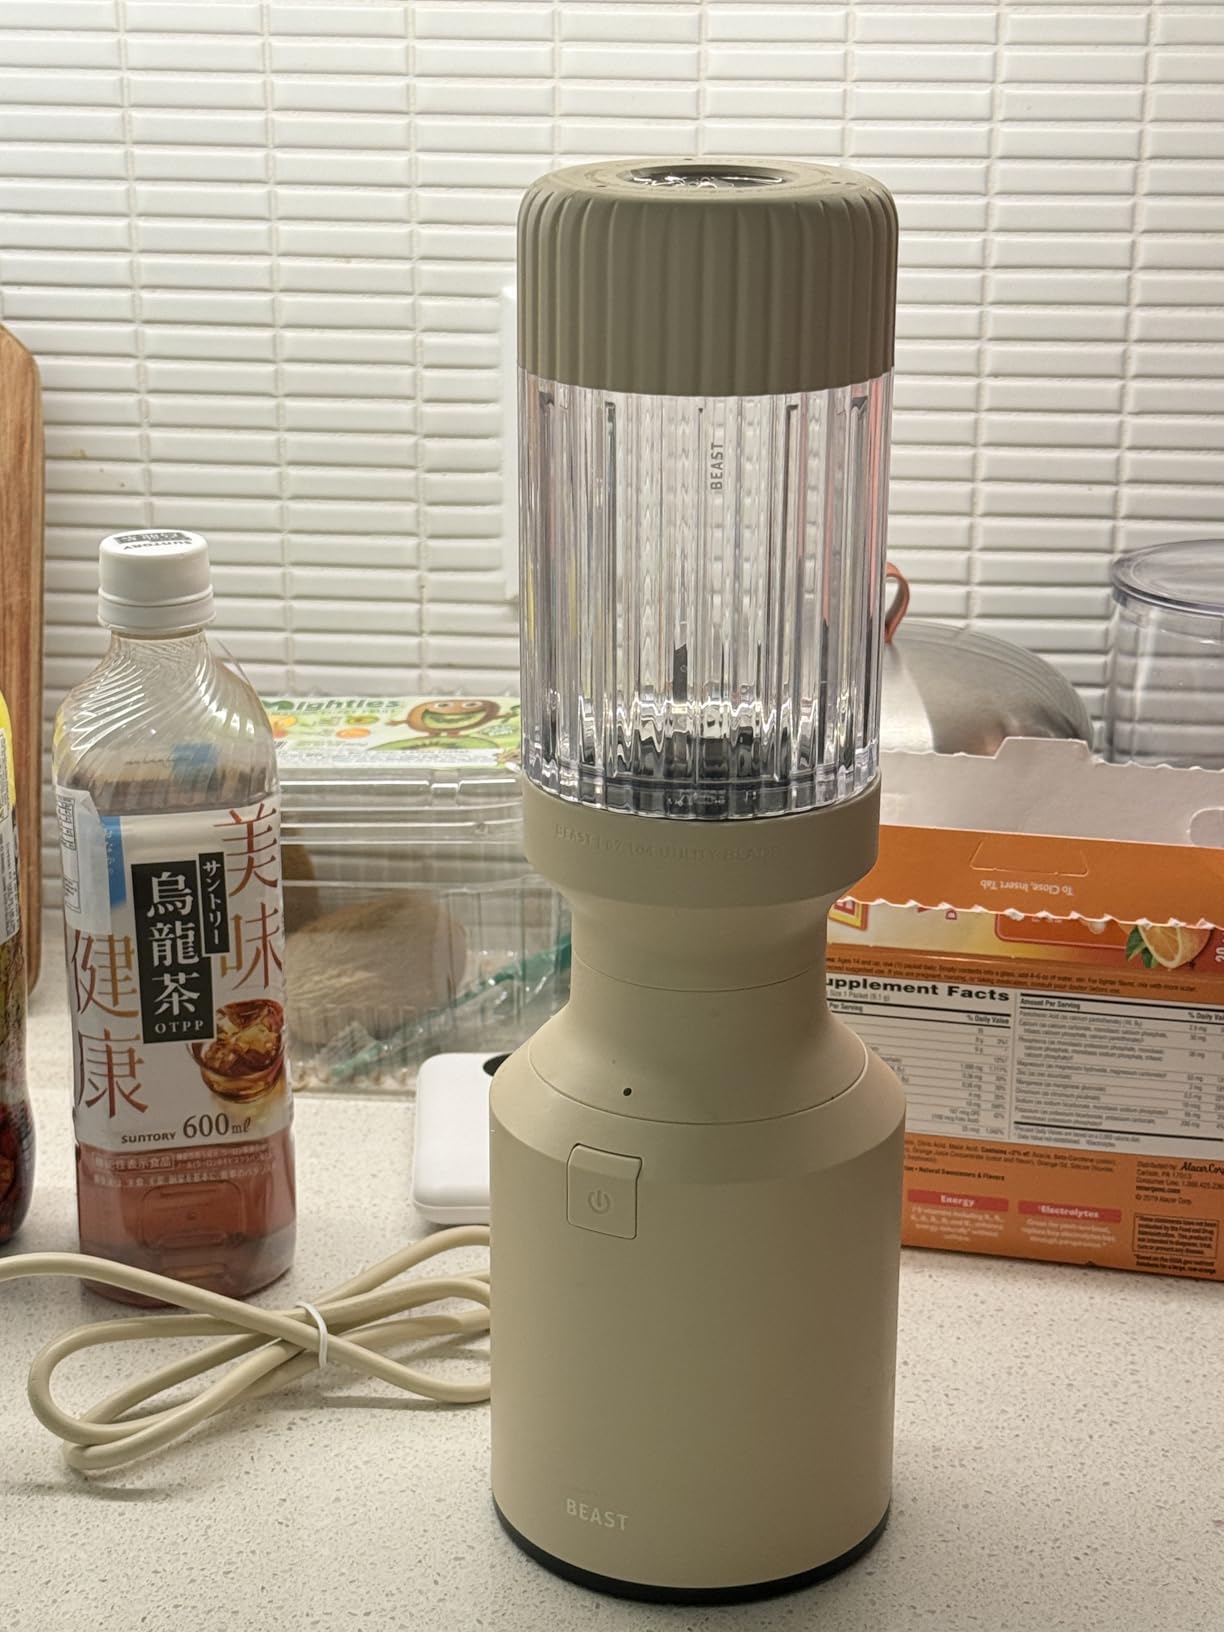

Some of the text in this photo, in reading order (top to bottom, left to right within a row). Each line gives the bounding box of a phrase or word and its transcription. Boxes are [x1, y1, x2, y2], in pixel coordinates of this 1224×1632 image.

[710, 442, 724, 490] BEAST
[213, 803, 283, 990] 美味
[980, 879, 998, 890] Tab
[999, 881, 1029, 892] Insert
[1061, 885, 1073, 896] To
[202, 860, 223, 945] サントリー
[147, 871, 200, 1016] 烏龍茶
[947, 986, 1010, 1001] Facts
[71, 929, 148, 1119] 健康
[155, 1019, 205, 1034] OTPP
[940, 1194, 976, 1208] Energy
[565, 1497, 630, 1532] BEAST
